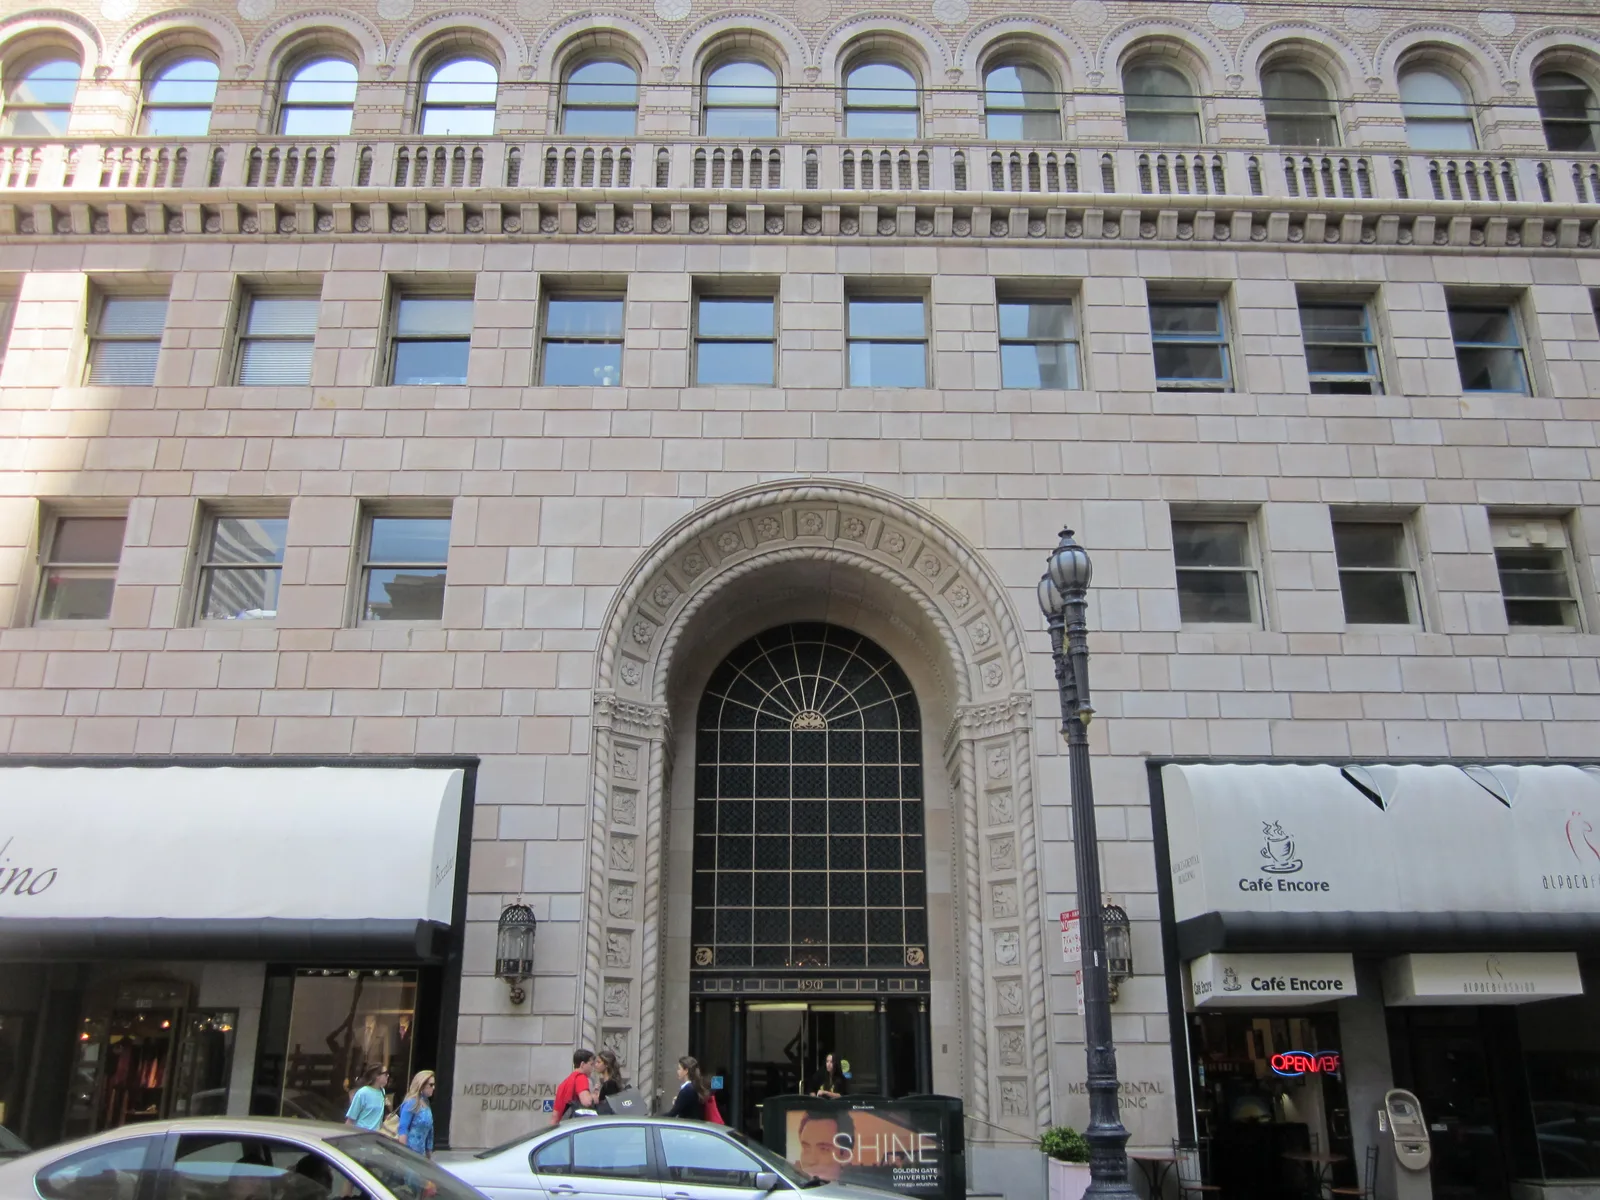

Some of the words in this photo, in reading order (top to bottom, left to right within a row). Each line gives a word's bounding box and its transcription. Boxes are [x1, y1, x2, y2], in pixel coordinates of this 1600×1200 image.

[0, 836, 58, 895] ino
[1239, 876, 1273, 891] Café
[1277, 879, 1330, 891] Encore
[800, 980, 823, 990] 490
[1251, 976, 1285, 991] Café
[1290, 977, 1343, 991] Encore
[1271, 1054, 1315, 1072] OPEN
[481, 1098, 541, 1112] BUILDING
[832, 1132, 938, 1164] SHINE
